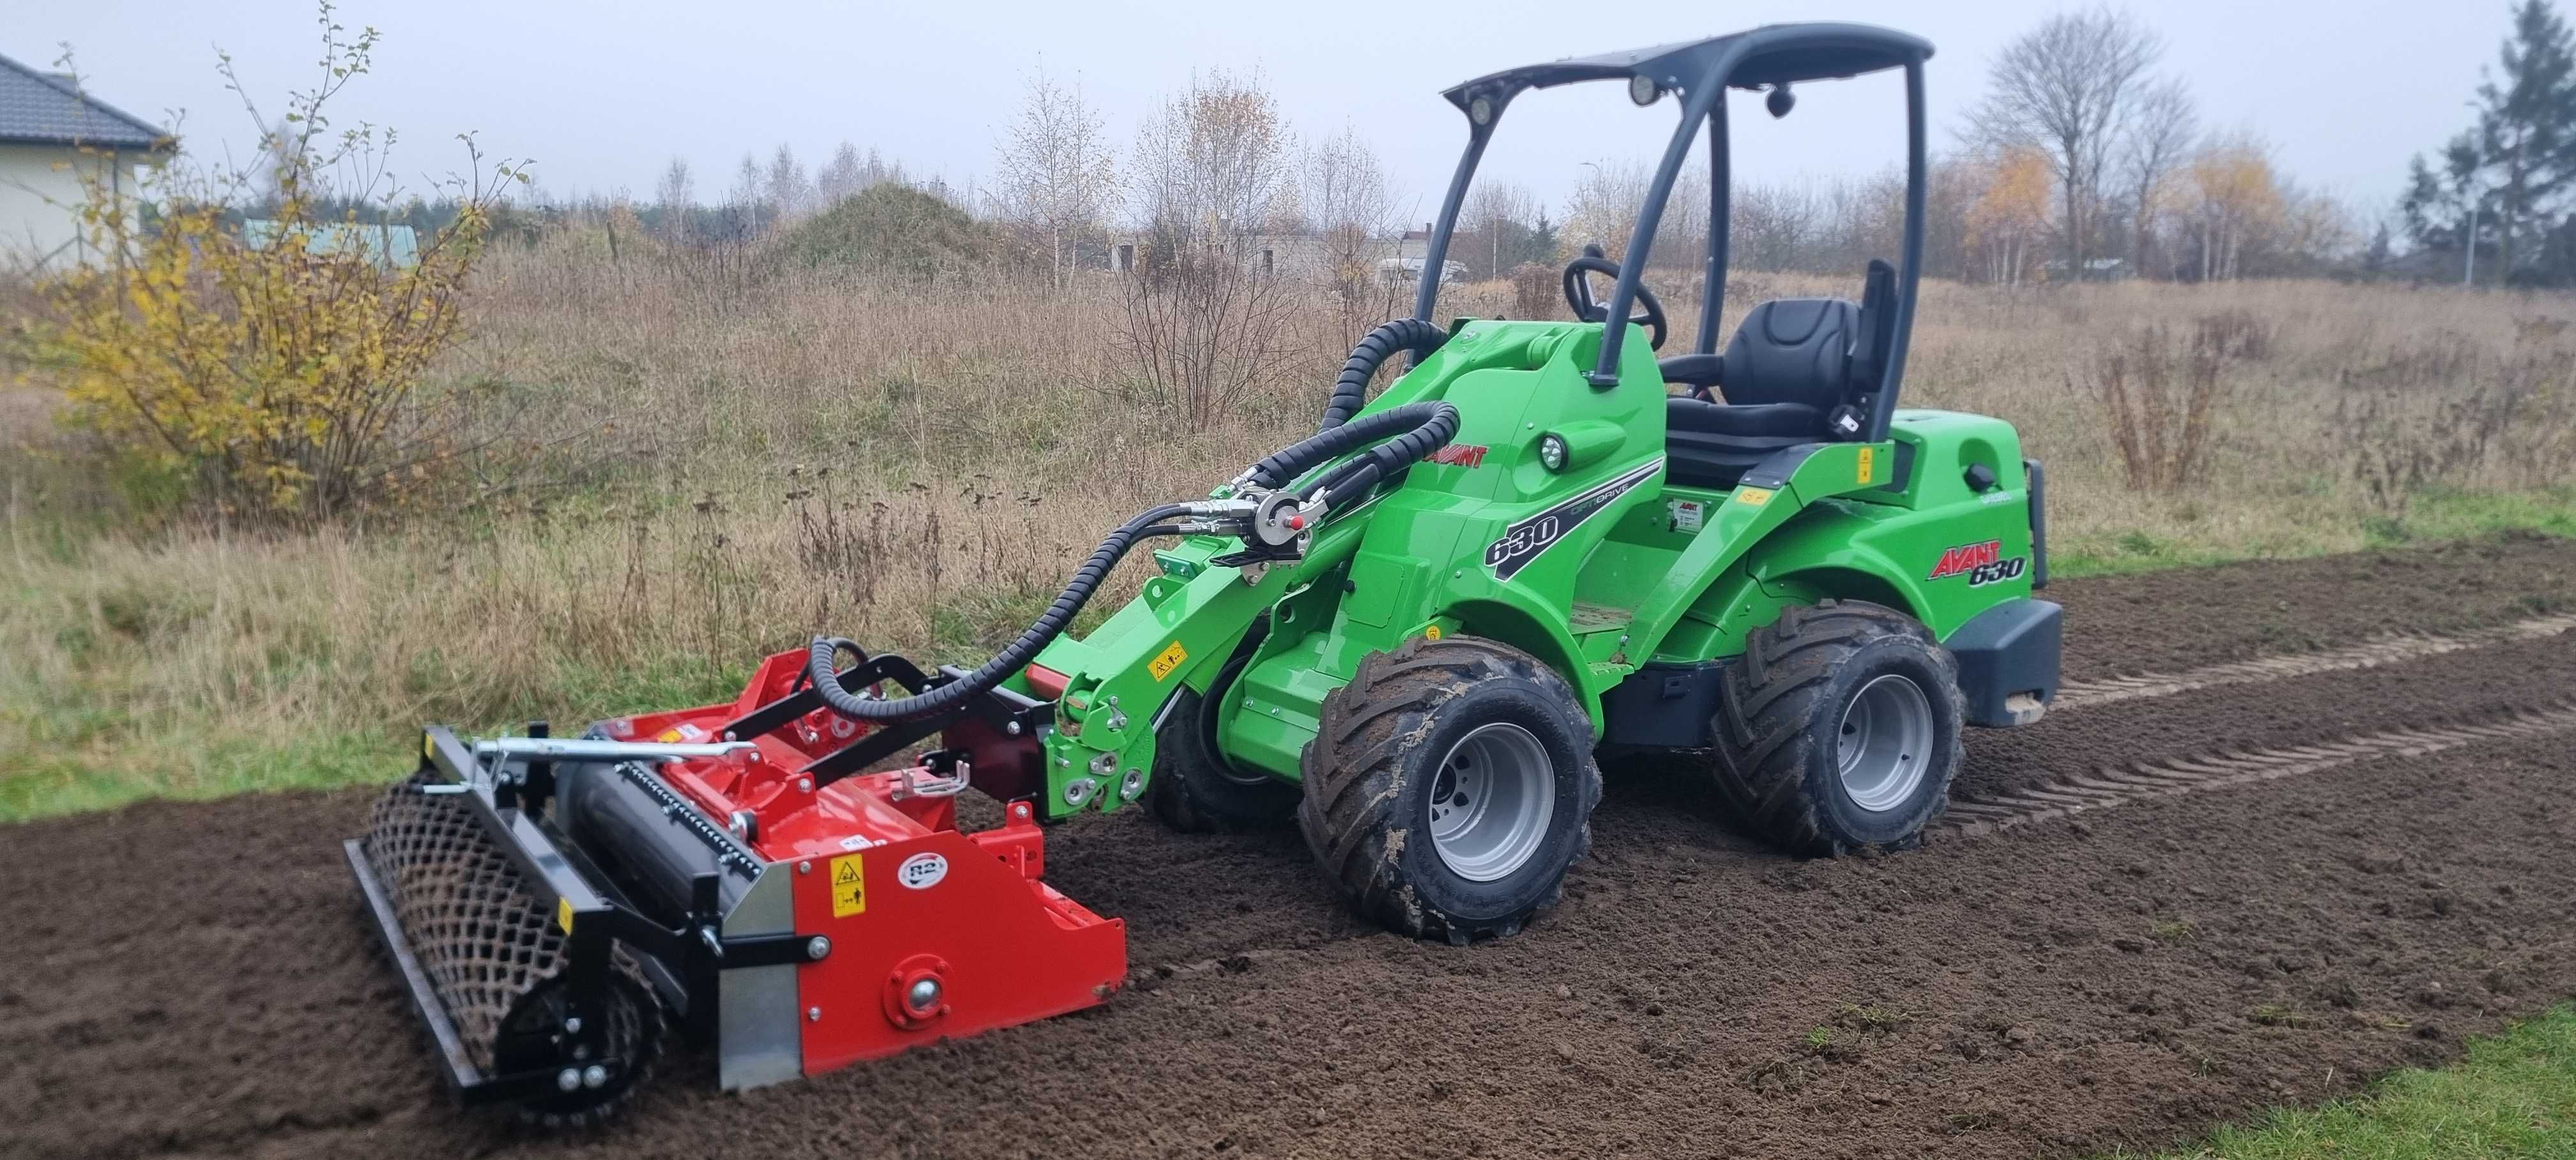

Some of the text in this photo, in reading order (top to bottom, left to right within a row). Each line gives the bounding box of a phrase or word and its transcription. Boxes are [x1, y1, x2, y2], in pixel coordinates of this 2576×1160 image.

[1421, 443, 1489, 469] AVANT
[1484, 515, 1558, 567] 630
[1926, 538, 2001, 581] AVANT
[1969, 556, 2027, 588] 630
